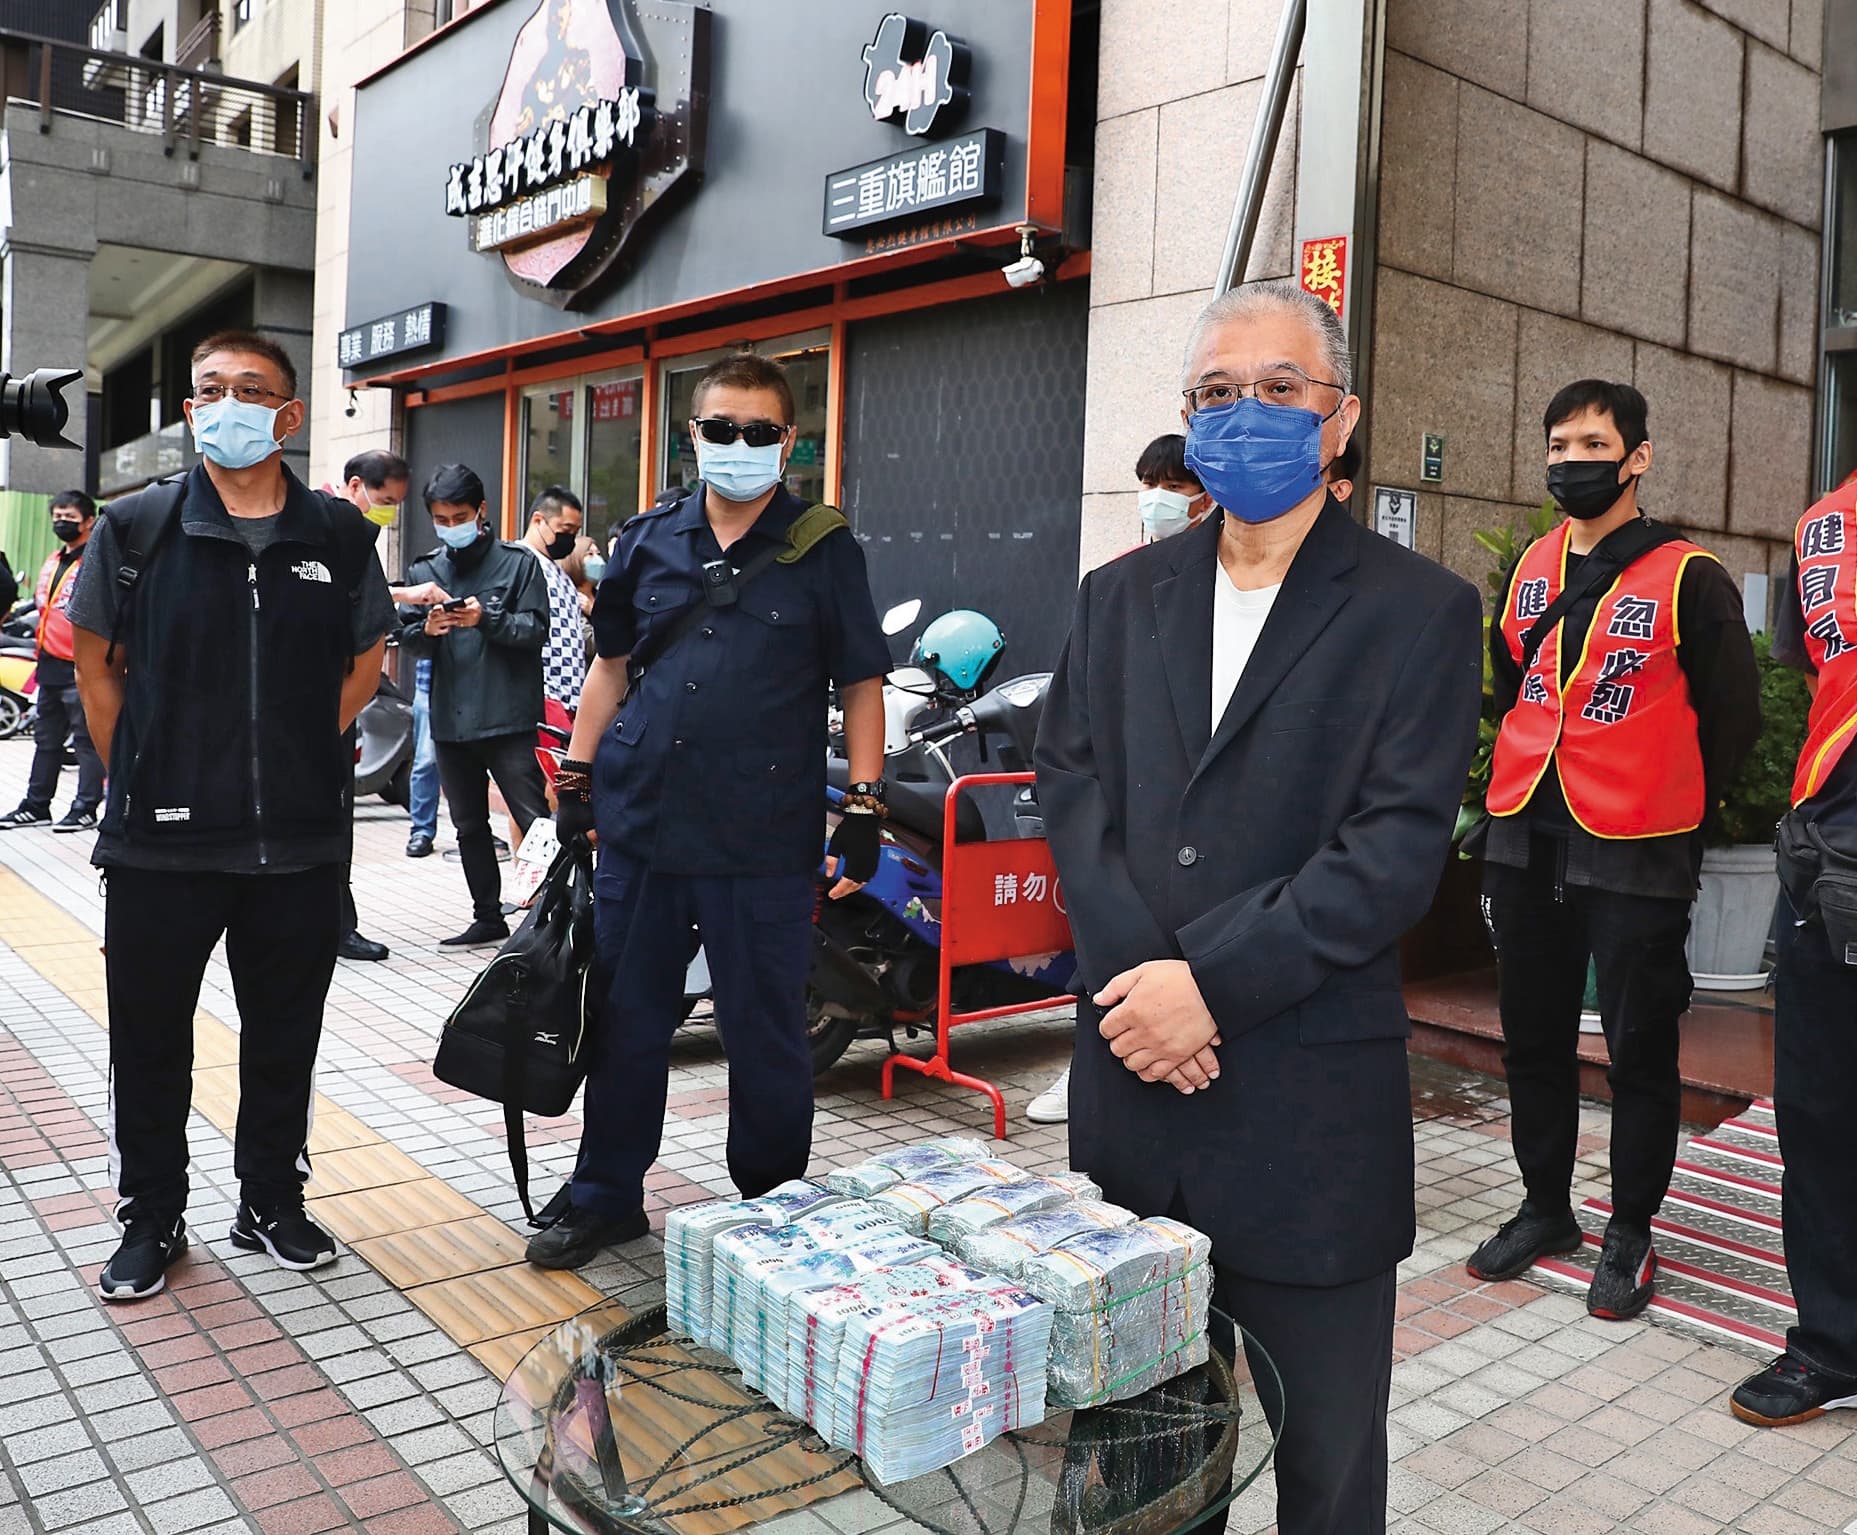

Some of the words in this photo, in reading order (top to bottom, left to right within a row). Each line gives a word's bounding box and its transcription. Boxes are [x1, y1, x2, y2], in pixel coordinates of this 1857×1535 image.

[873, 54, 938, 120] 24H
[446, 86, 640, 215] 成吉思汗健身俱樂部
[830, 141, 981, 224] 三重旗艦館
[1303, 248, 1342, 309] 接
[340, 331, 362, 363] 專業
[370, 321, 396, 355] 服務
[404, 308, 431, 345] 熱情
[1581, 595, 1658, 724] 忽必烈
[994, 872, 1048, 906] 請勿
